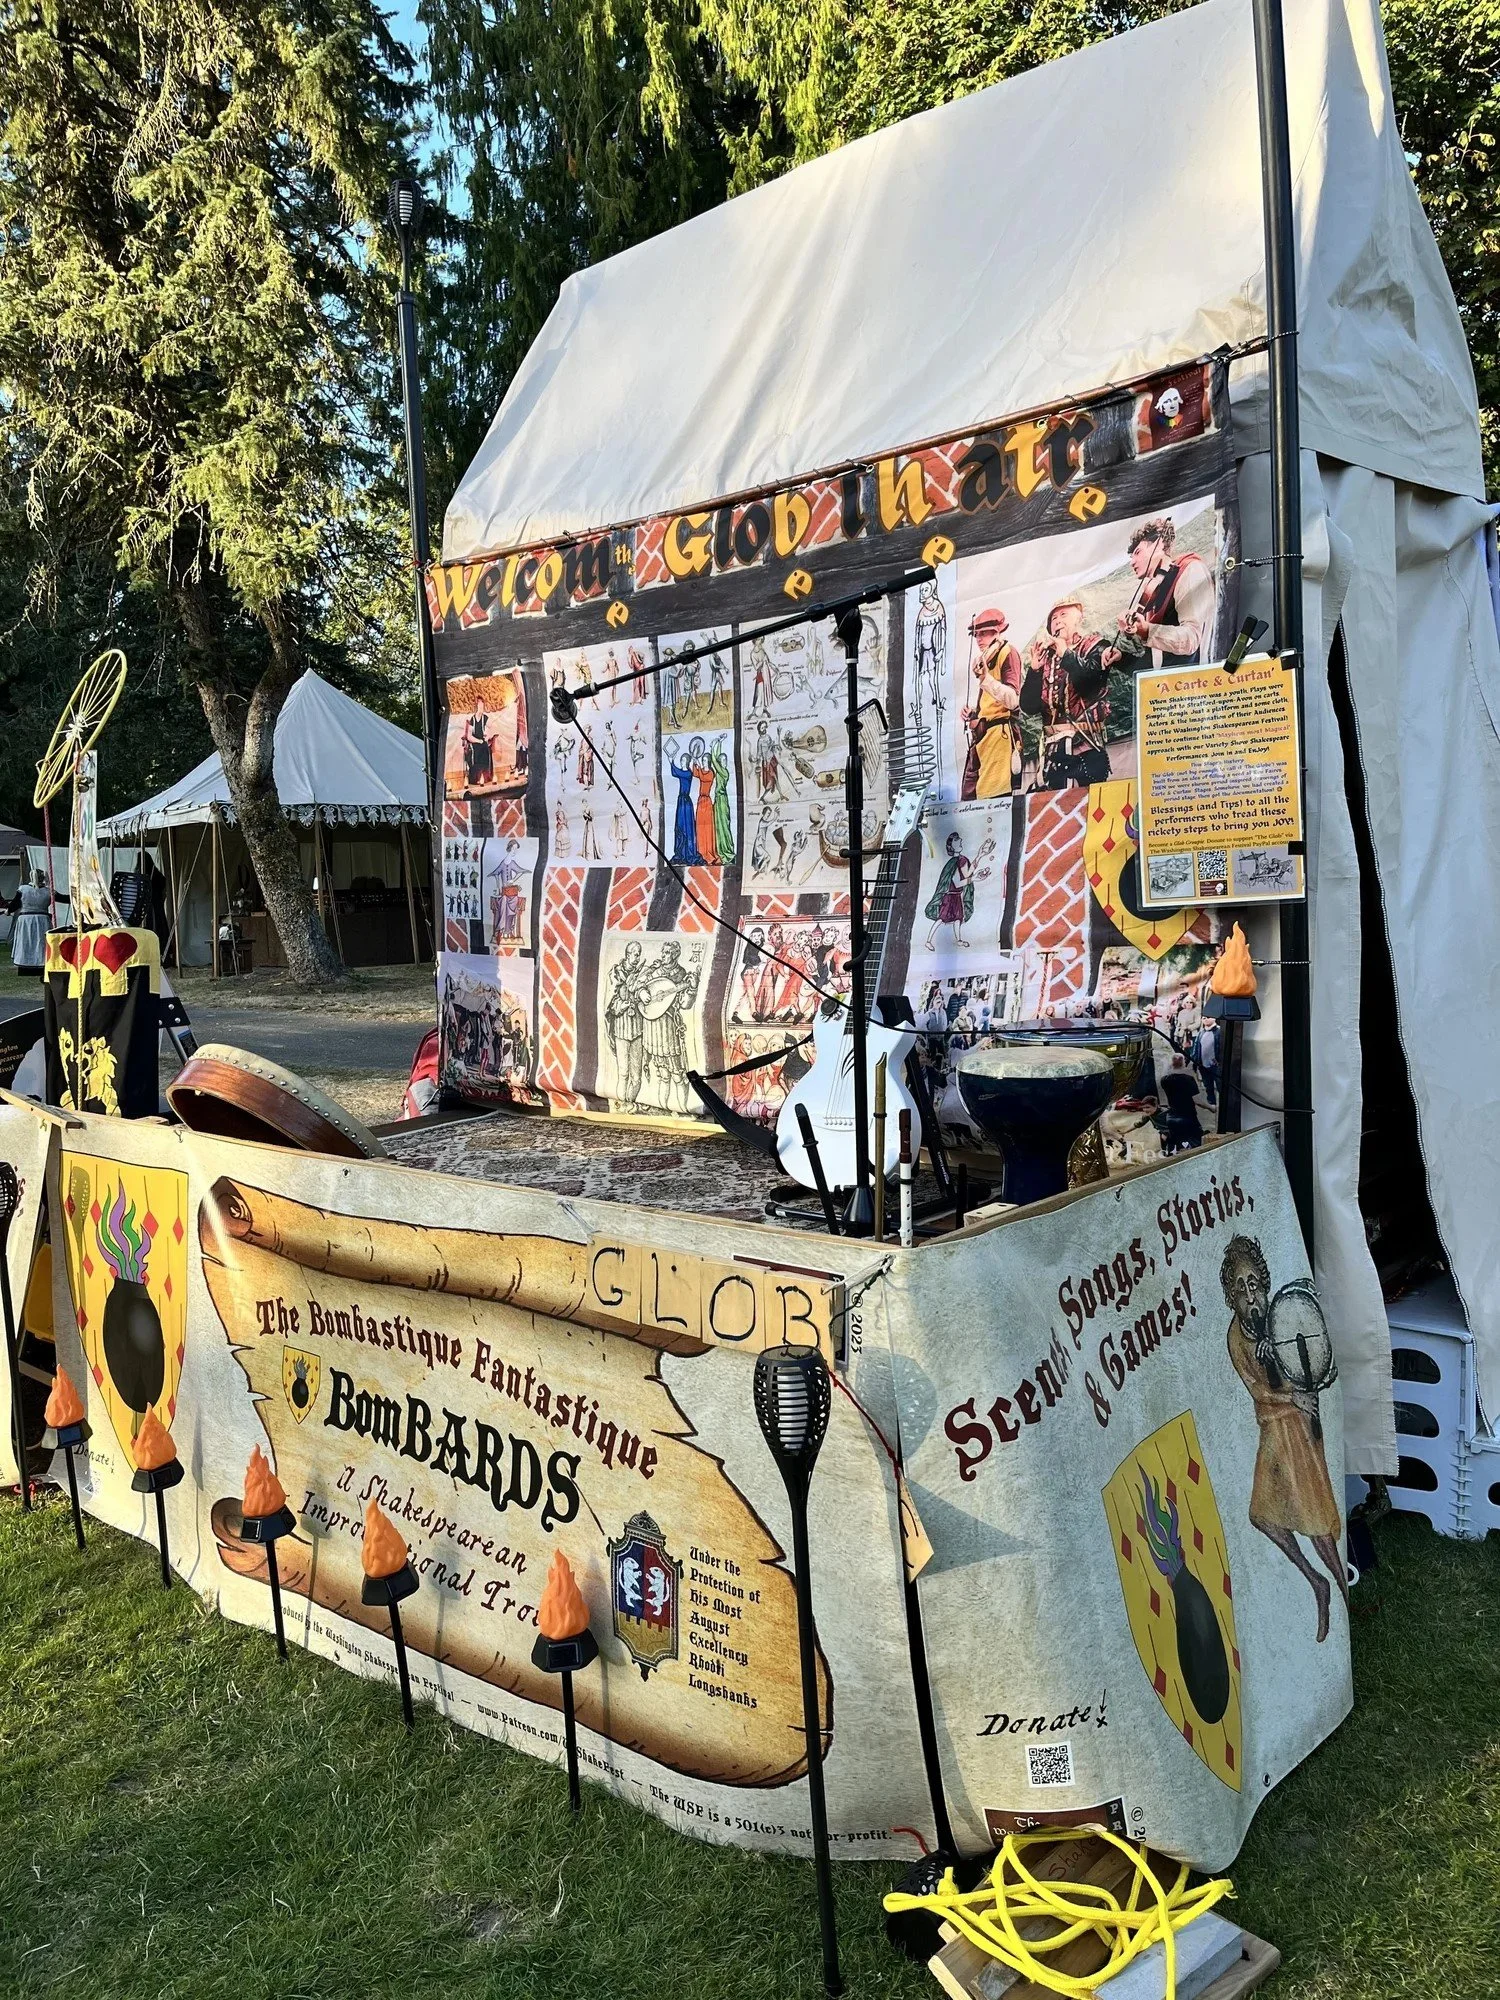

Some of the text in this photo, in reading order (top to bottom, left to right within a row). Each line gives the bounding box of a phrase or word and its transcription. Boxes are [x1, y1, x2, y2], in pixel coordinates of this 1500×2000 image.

[1148, 698, 1167, 706] When
[1168, 692, 1206, 703] Shakespeare
[1268, 682, 1284, 690] were
[1173, 676, 1208, 691] Carte
[1212, 674, 1223, 686] &
[1147, 720, 1167, 728] Actors
[1188, 713, 1226, 724] Imagination
[1236, 709, 1252, 717] their
[1152, 703, 1177, 713] brought
[1186, 694, 1252, 709] Stratford-upon-Avon
[1190, 707, 1204, 715] Just
[1211, 703, 1239, 713] platform
[1172, 734, 1199, 743] continue
[1173, 724, 1211, 735] Washington
[1211, 718, 1259, 730] Shakespearean
[1146, 747, 1174, 755] approach
[1204, 741, 1229, 750] Variety
[1249, 734, 1290, 745] Shakespeare
[1150, 794, 1290, 816] Blessings (and Tips) to all the
[1154, 807, 1287, 826] performers who tread these
[1147, 827, 1180, 838] rickety
[1183, 824, 1208, 835] steps
[1223, 821, 1249, 832] bring
[1251, 821, 1269, 830] you
[1058, 1237, 1155, 1350] Songs,
[1156, 1174, 1254, 1267] Stories,
[592, 1246, 820, 1358] GLOB
[851, 1313, 863, 1355] 2023
[1085, 1269, 1197, 1428] & Games!
[256, 1296, 658, 1480] The Bombastique Fantastique
[324, 1366, 582, 1533] BomBARDS
[359, 1474, 528, 1577] Shakespearean
[690, 1546, 740, 1576] Under the
[690, 1567, 760, 1604] Protection of
[690, 1588, 742, 1619] His Most
[689, 1610, 730, 1637] August
[689, 1631, 748, 1666] Excellency
[688, 1673, 757, 1708] Longshanks
[313, 1620, 323, 1635] the
[325, 1626, 362, 1658] Washington
[422, 1677, 455, 1702] Festival
[649, 1783, 669, 1803] The
[708, 1808, 719, 1822] is
[725, 1817, 731, 1827] a
[735, 1817, 786, 1835] 501(c)3
